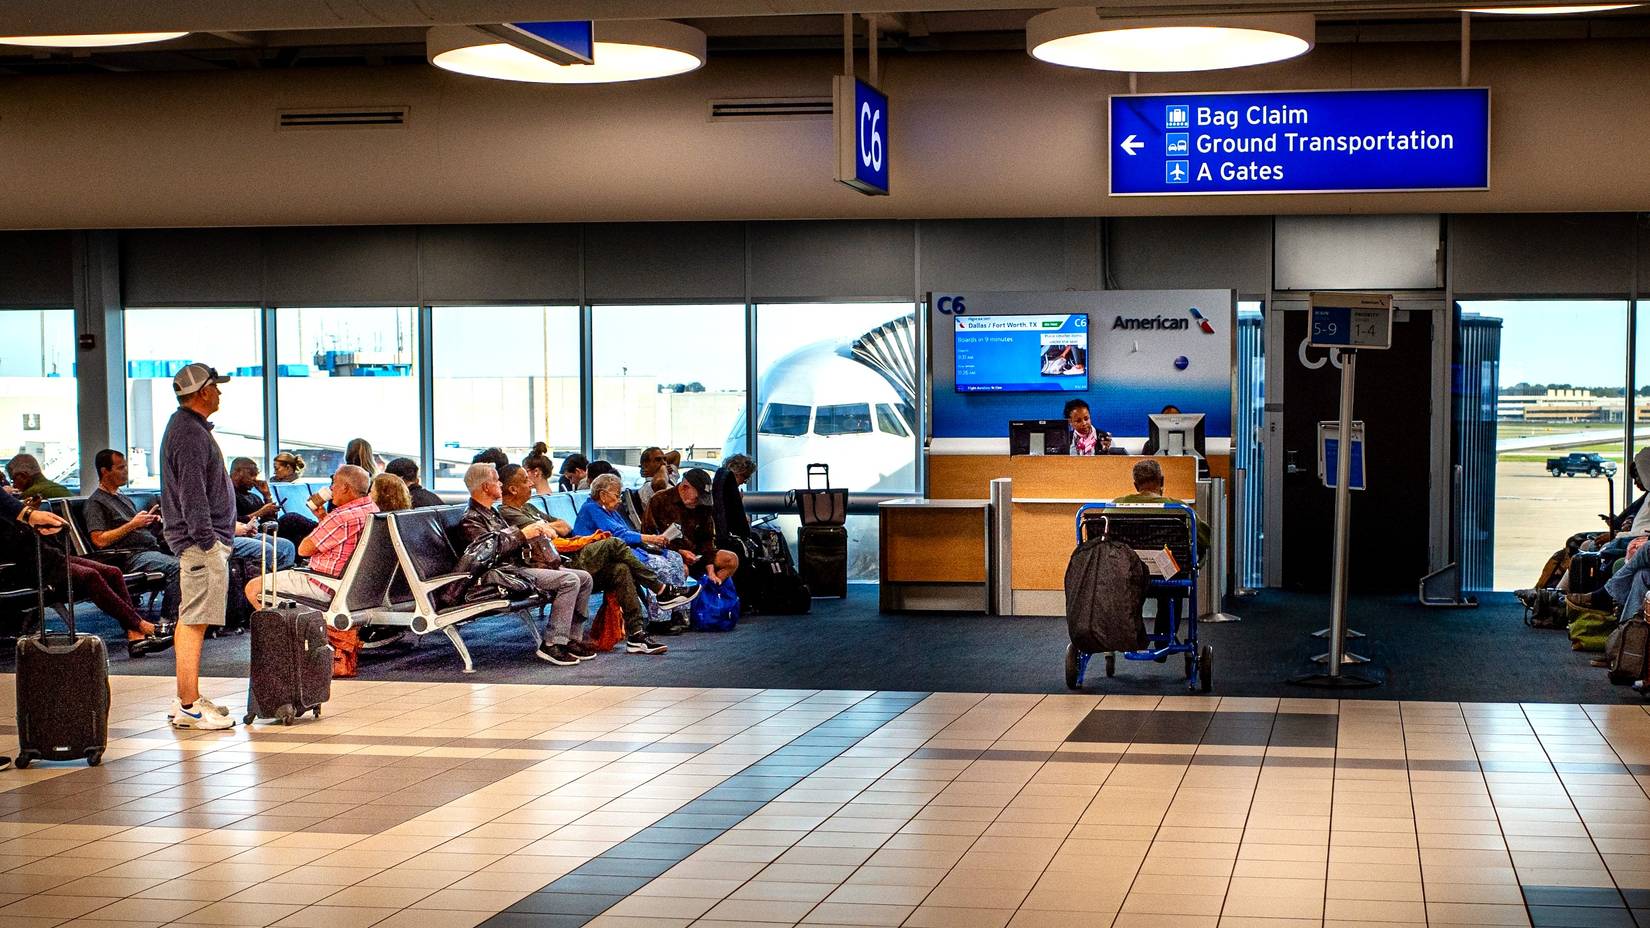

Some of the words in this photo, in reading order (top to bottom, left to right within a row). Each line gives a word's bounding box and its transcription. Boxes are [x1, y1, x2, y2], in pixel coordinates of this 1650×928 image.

[1197, 107, 1238, 129] Bag
[1246, 105, 1308, 124] Claim
[861, 101, 882, 172] C6
[1197, 134, 1276, 154] Ground
[1285, 130, 1454, 155] Transportation
[1197, 163, 1213, 181] A
[1220, 162, 1284, 181] Gates
[937, 296, 966, 315] C6
[1074, 318, 1087, 327] C6
[1112, 315, 1189, 330] American
[1313, 322, 1337, 336] 5-9
